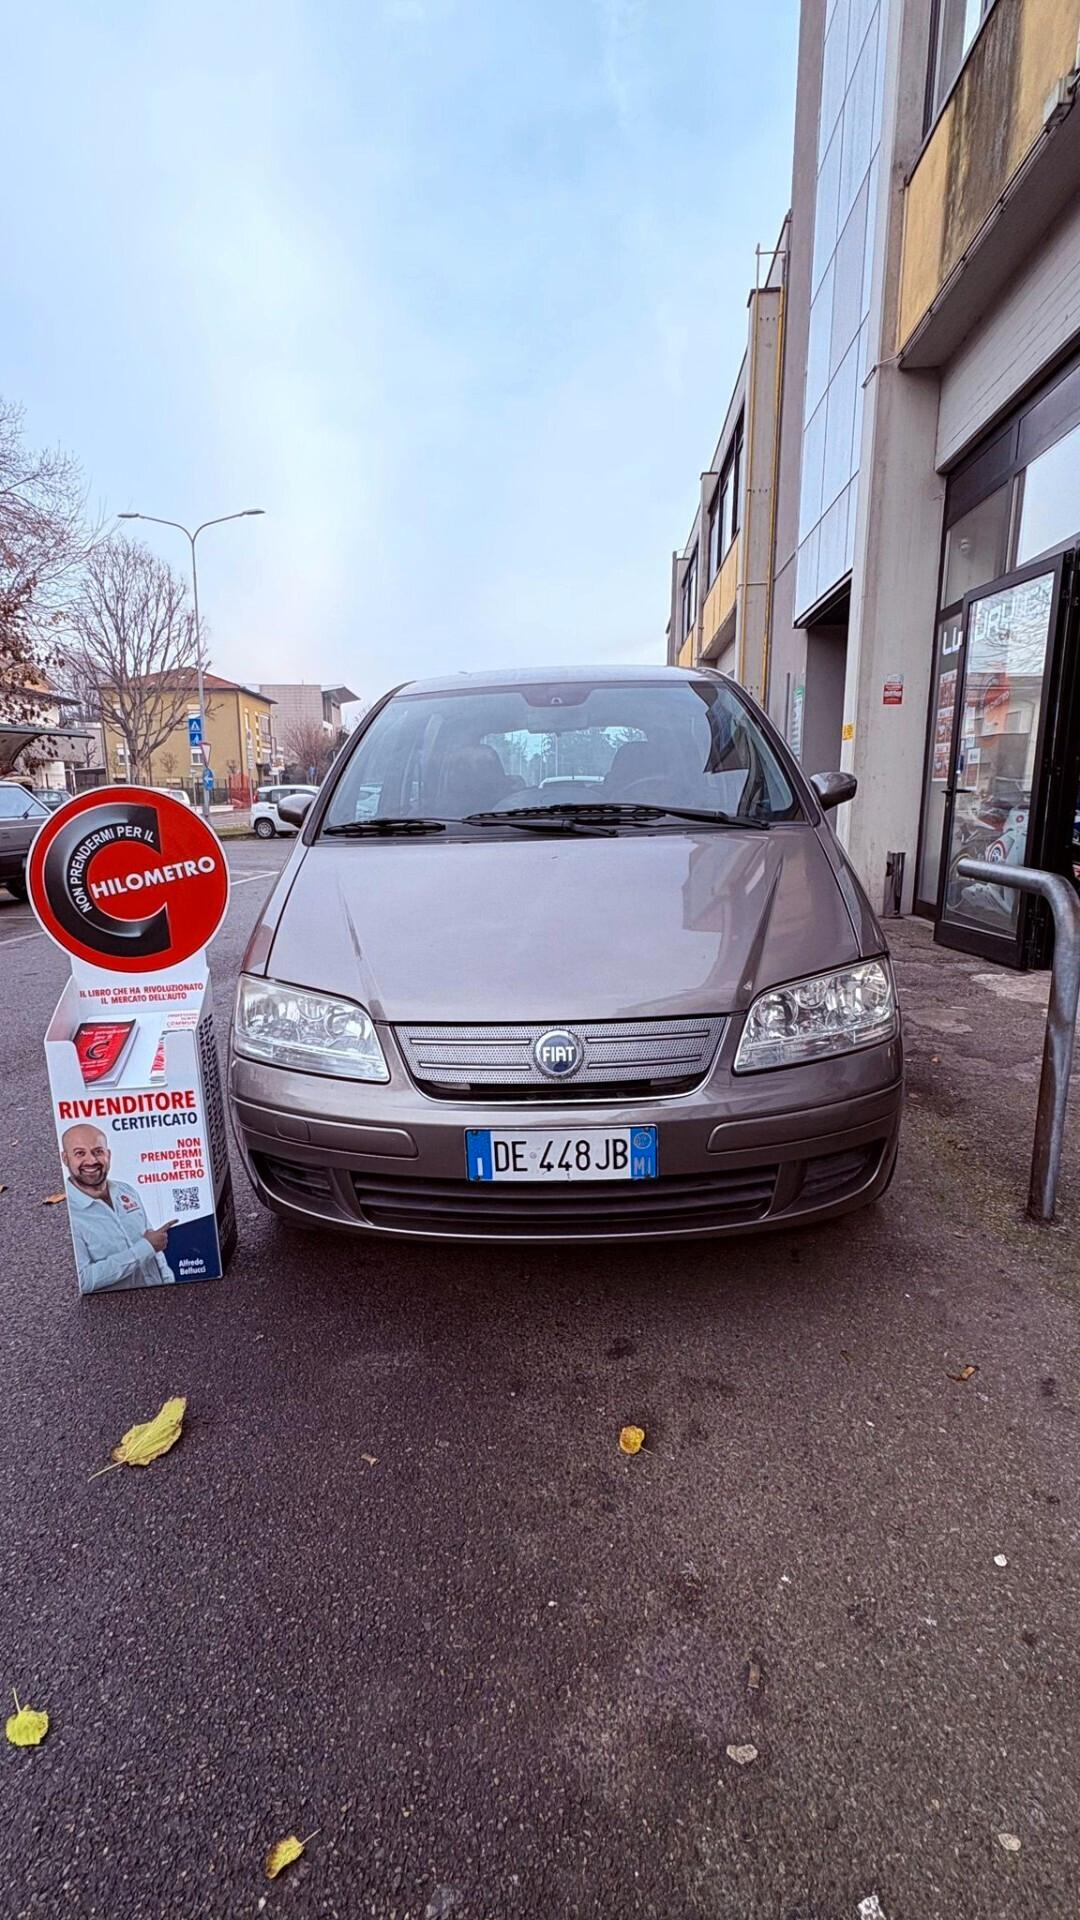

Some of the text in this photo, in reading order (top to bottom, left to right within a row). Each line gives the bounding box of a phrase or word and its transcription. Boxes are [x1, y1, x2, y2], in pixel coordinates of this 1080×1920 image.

[70, 825, 154, 913] NON PRENDERMI PER IL
[79, 990, 87, 998] IL
[88, 988, 112, 998] LIBRO
[113, 987, 128, 996] CHE
[143, 982, 204, 993] RIVOLUZIONATO
[101, 992, 187, 1005] IL MERCATO DELL'AUTO
[542, 1046, 575, 1062] FIAT
[58, 1090, 196, 1119] RIVENDITORE
[112, 1112, 198, 1131] CERTIFICATO
[177, 1138, 201, 1148] NON
[140, 1149, 202, 1162] PRENDERMI
[494, 1141, 528, 1172] DE
[173, 1159, 204, 1170] PER IL
[137, 1169, 204, 1184] CHILOMETRO
[178, 1258, 204, 1267] Alfredo
[179, 1266, 206, 1275] Bellucci
